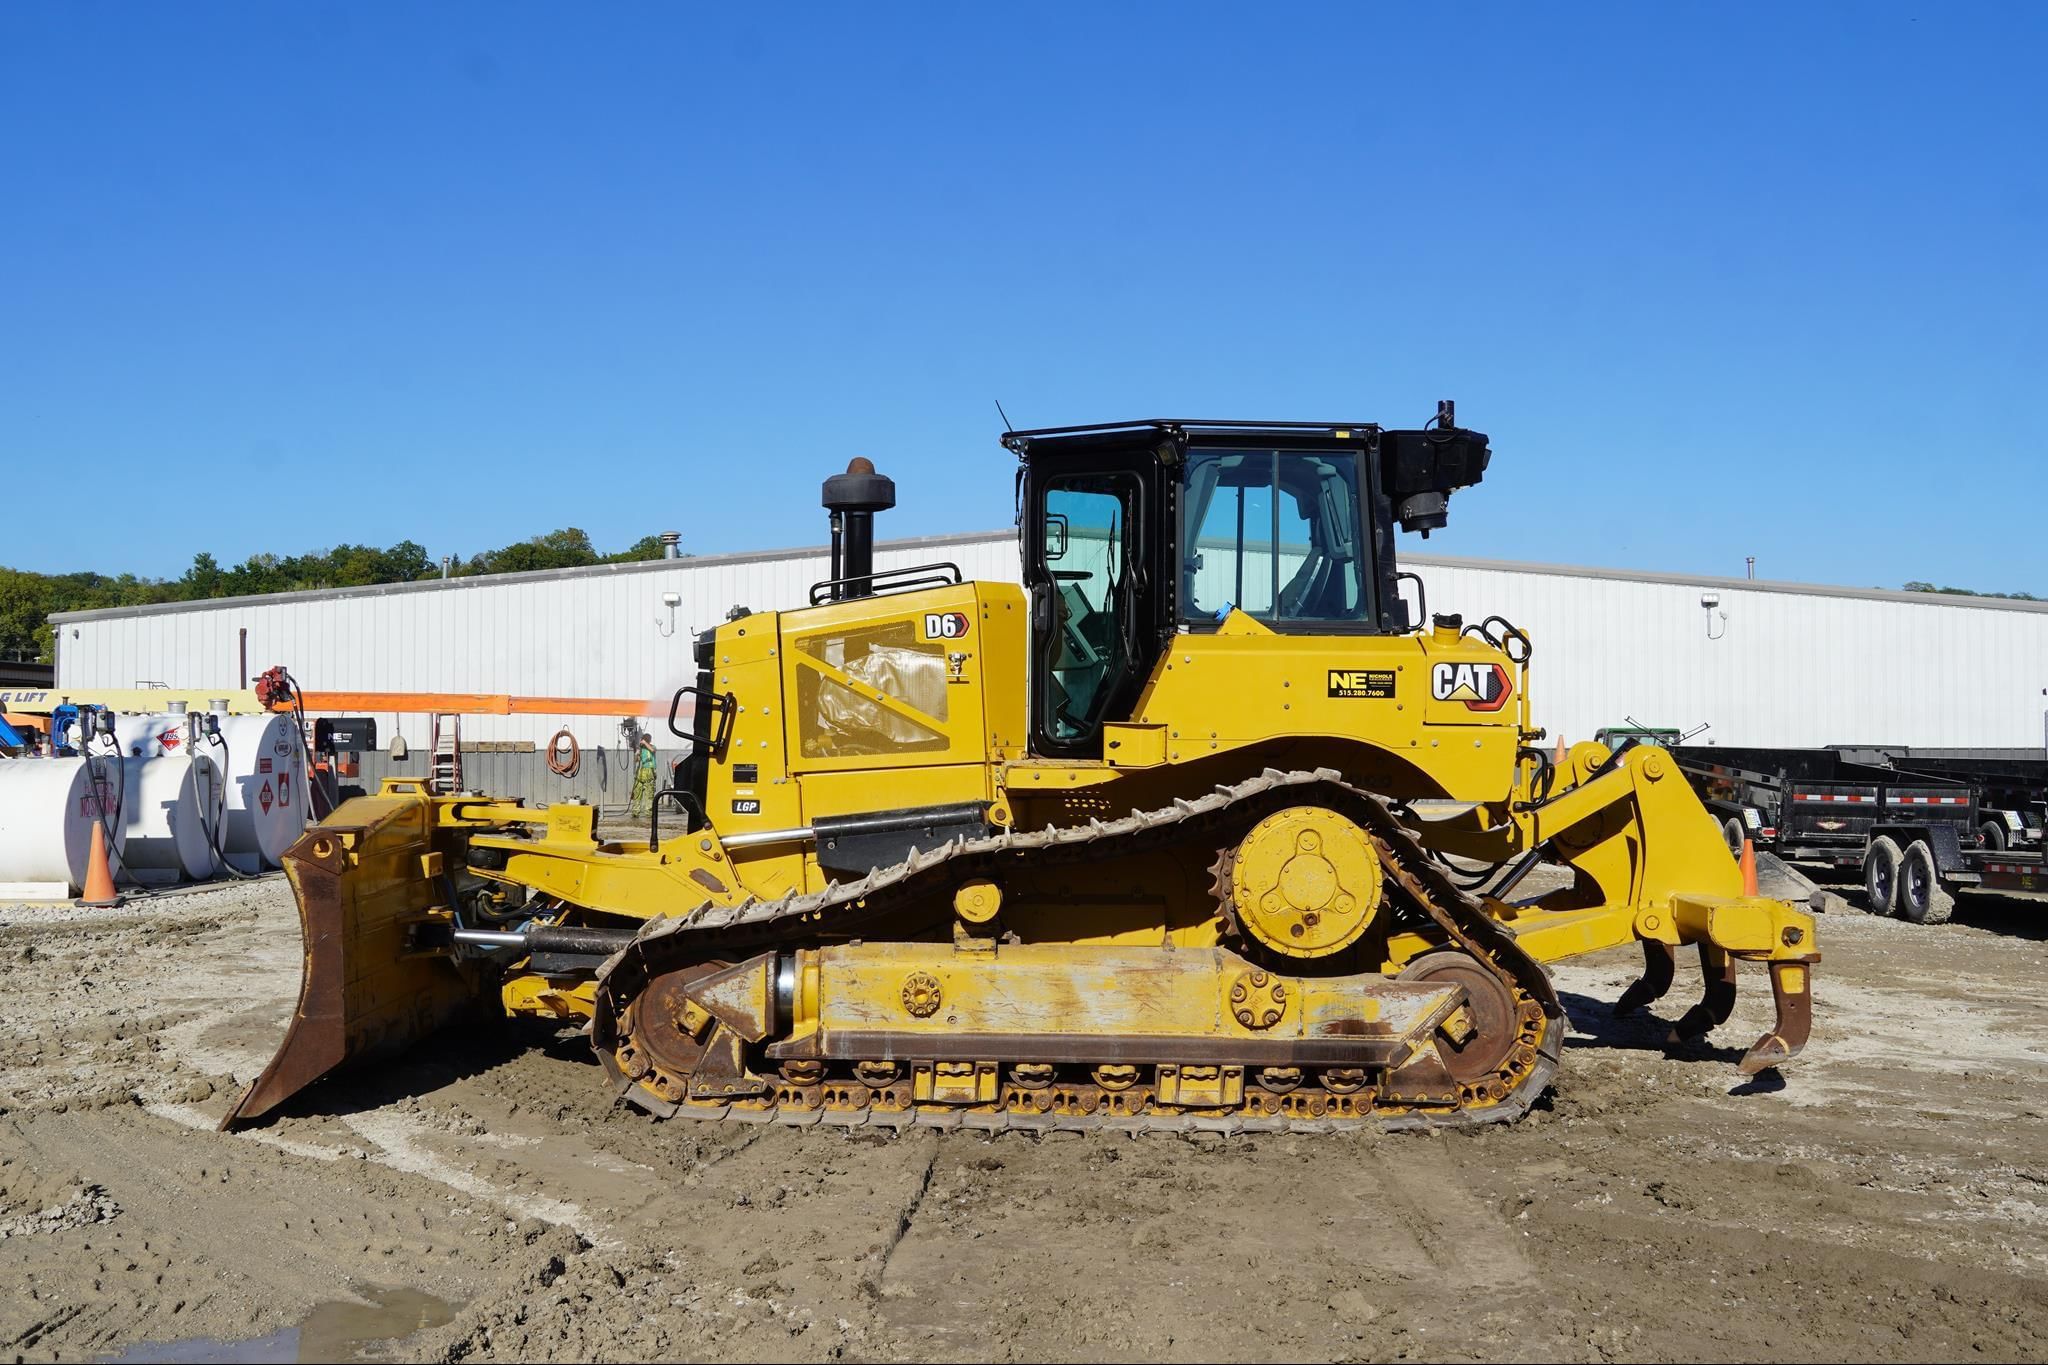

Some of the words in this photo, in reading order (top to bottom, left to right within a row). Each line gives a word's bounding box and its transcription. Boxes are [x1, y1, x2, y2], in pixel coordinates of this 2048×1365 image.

[926, 614, 956, 637] D6
[1331, 673, 1367, 689] NE
[1433, 663, 1492, 700] CAT
[15, 692, 47, 702] LIFT
[736, 802, 757, 812] LGP
